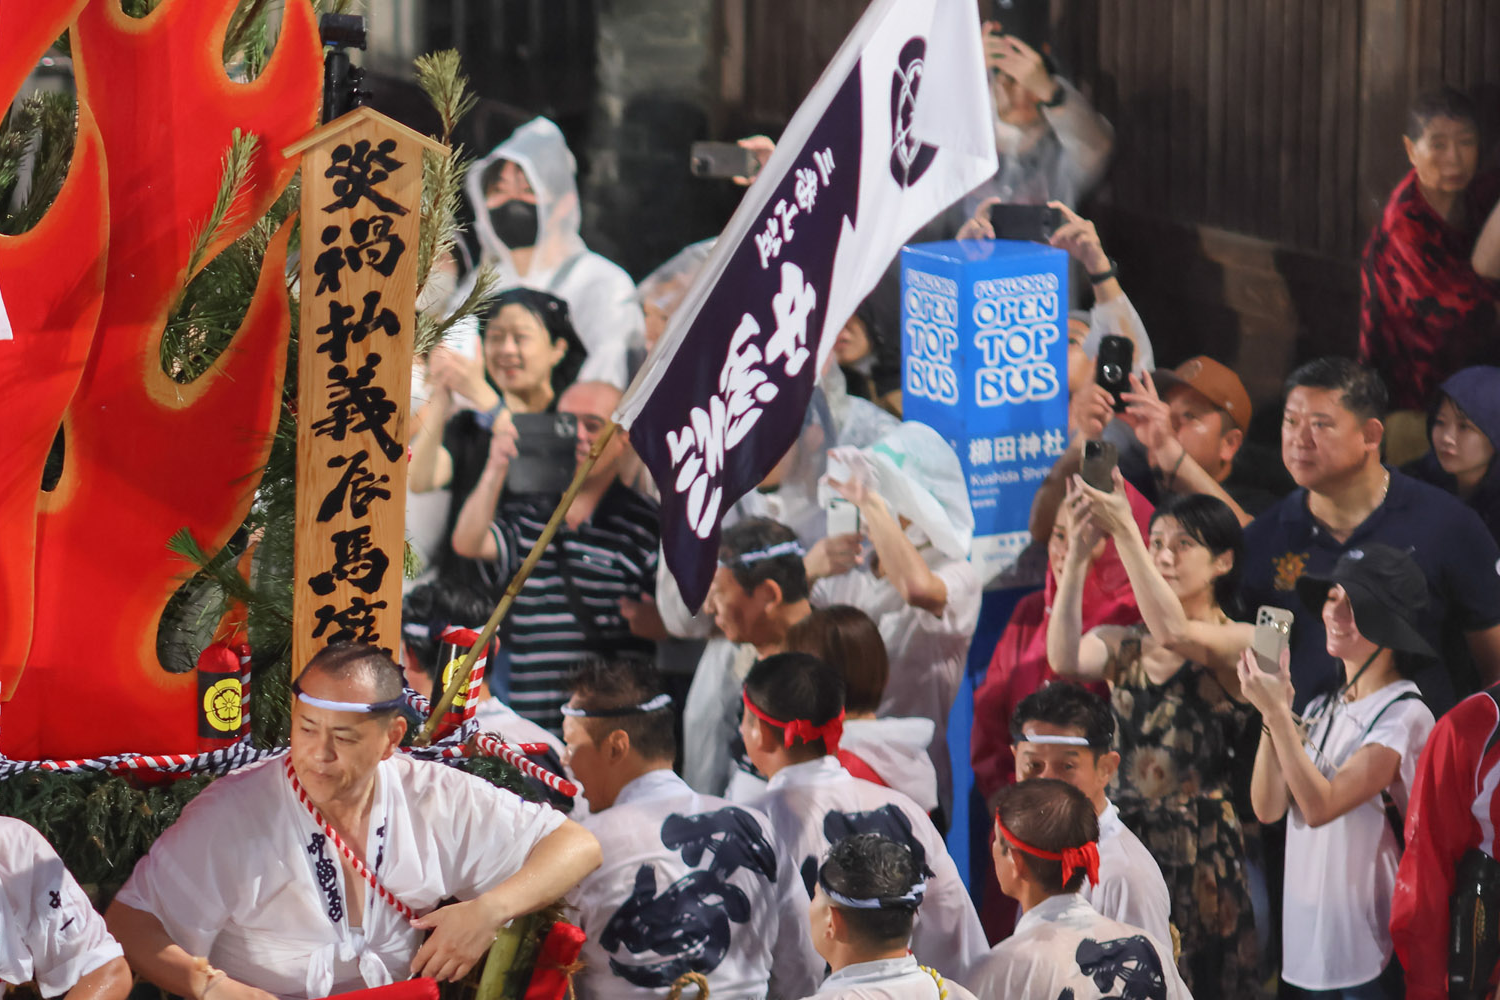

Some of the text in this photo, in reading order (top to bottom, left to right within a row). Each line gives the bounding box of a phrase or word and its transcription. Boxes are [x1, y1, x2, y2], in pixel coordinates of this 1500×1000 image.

[905, 286, 959, 328] OPEN
[972, 291, 1059, 329] OPEN
[906, 318, 959, 364] TOP
[974, 323, 1060, 366] TOP
[906, 354, 959, 406] BUS
[975, 362, 1060, 407] BUS
